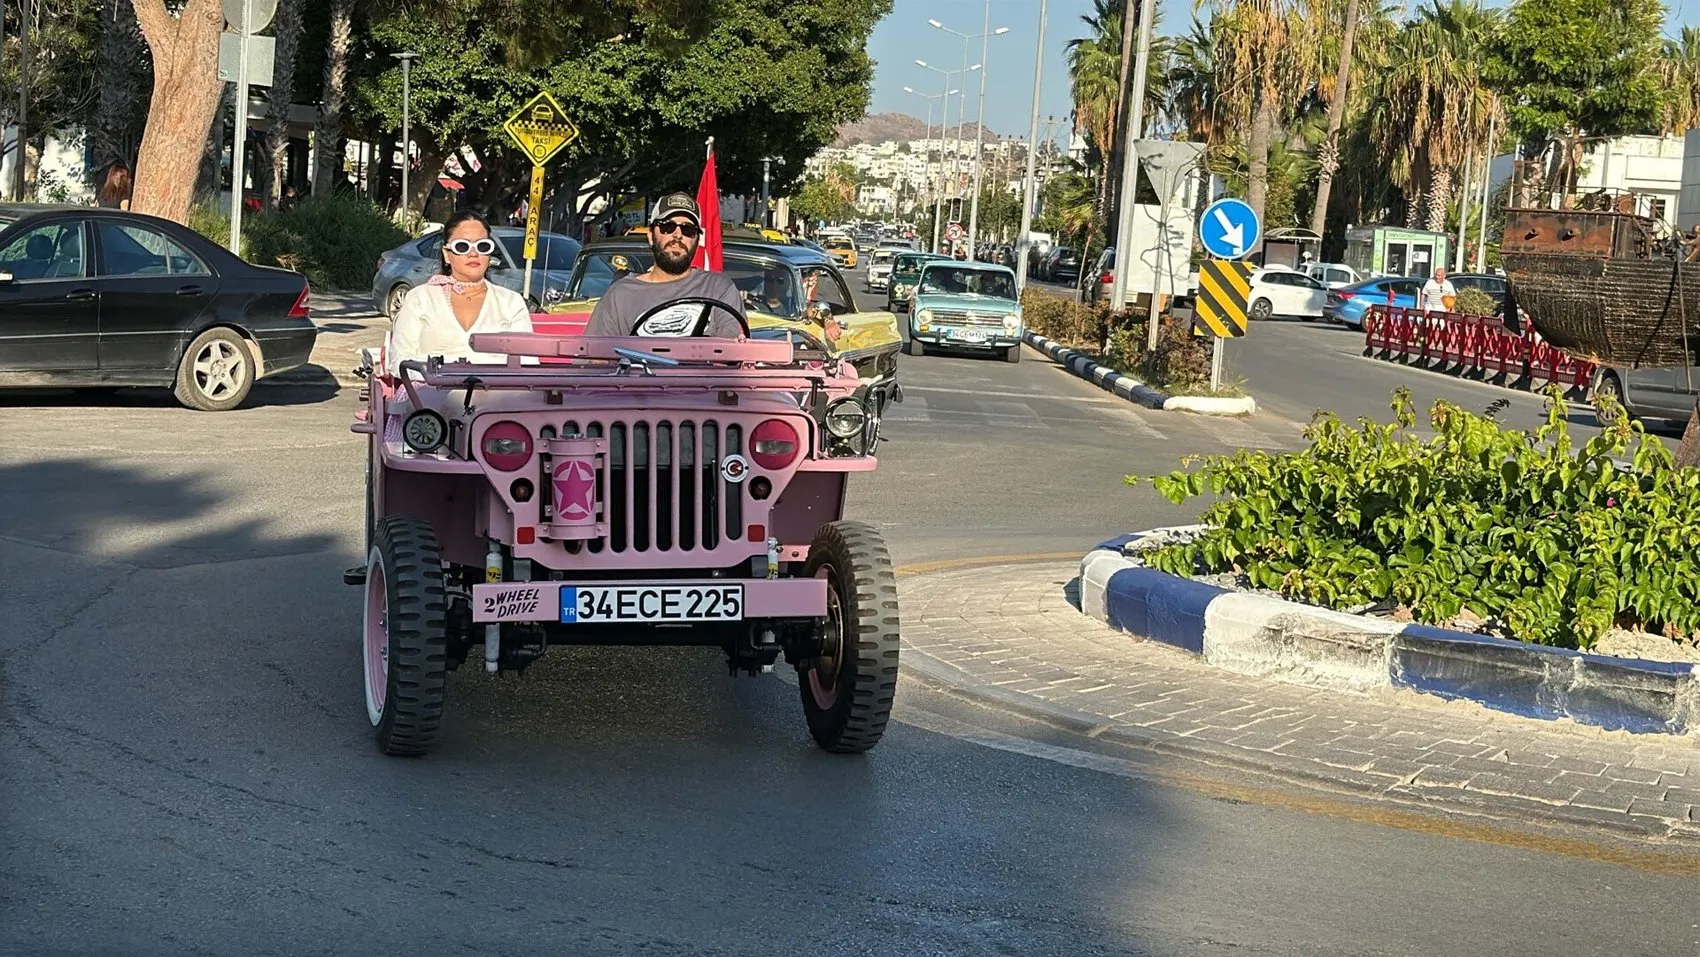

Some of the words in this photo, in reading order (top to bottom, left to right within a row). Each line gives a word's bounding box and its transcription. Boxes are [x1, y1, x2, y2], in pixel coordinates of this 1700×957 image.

[533, 176, 540, 195] 44
[527, 206, 538, 247] ARAÇ
[484, 597, 496, 613] 2
[496, 588, 540, 605] WHEEL
[497, 601, 540, 619] DRIVE
[563, 607, 576, 616] TR
[577, 588, 741, 619] 34ECE225
